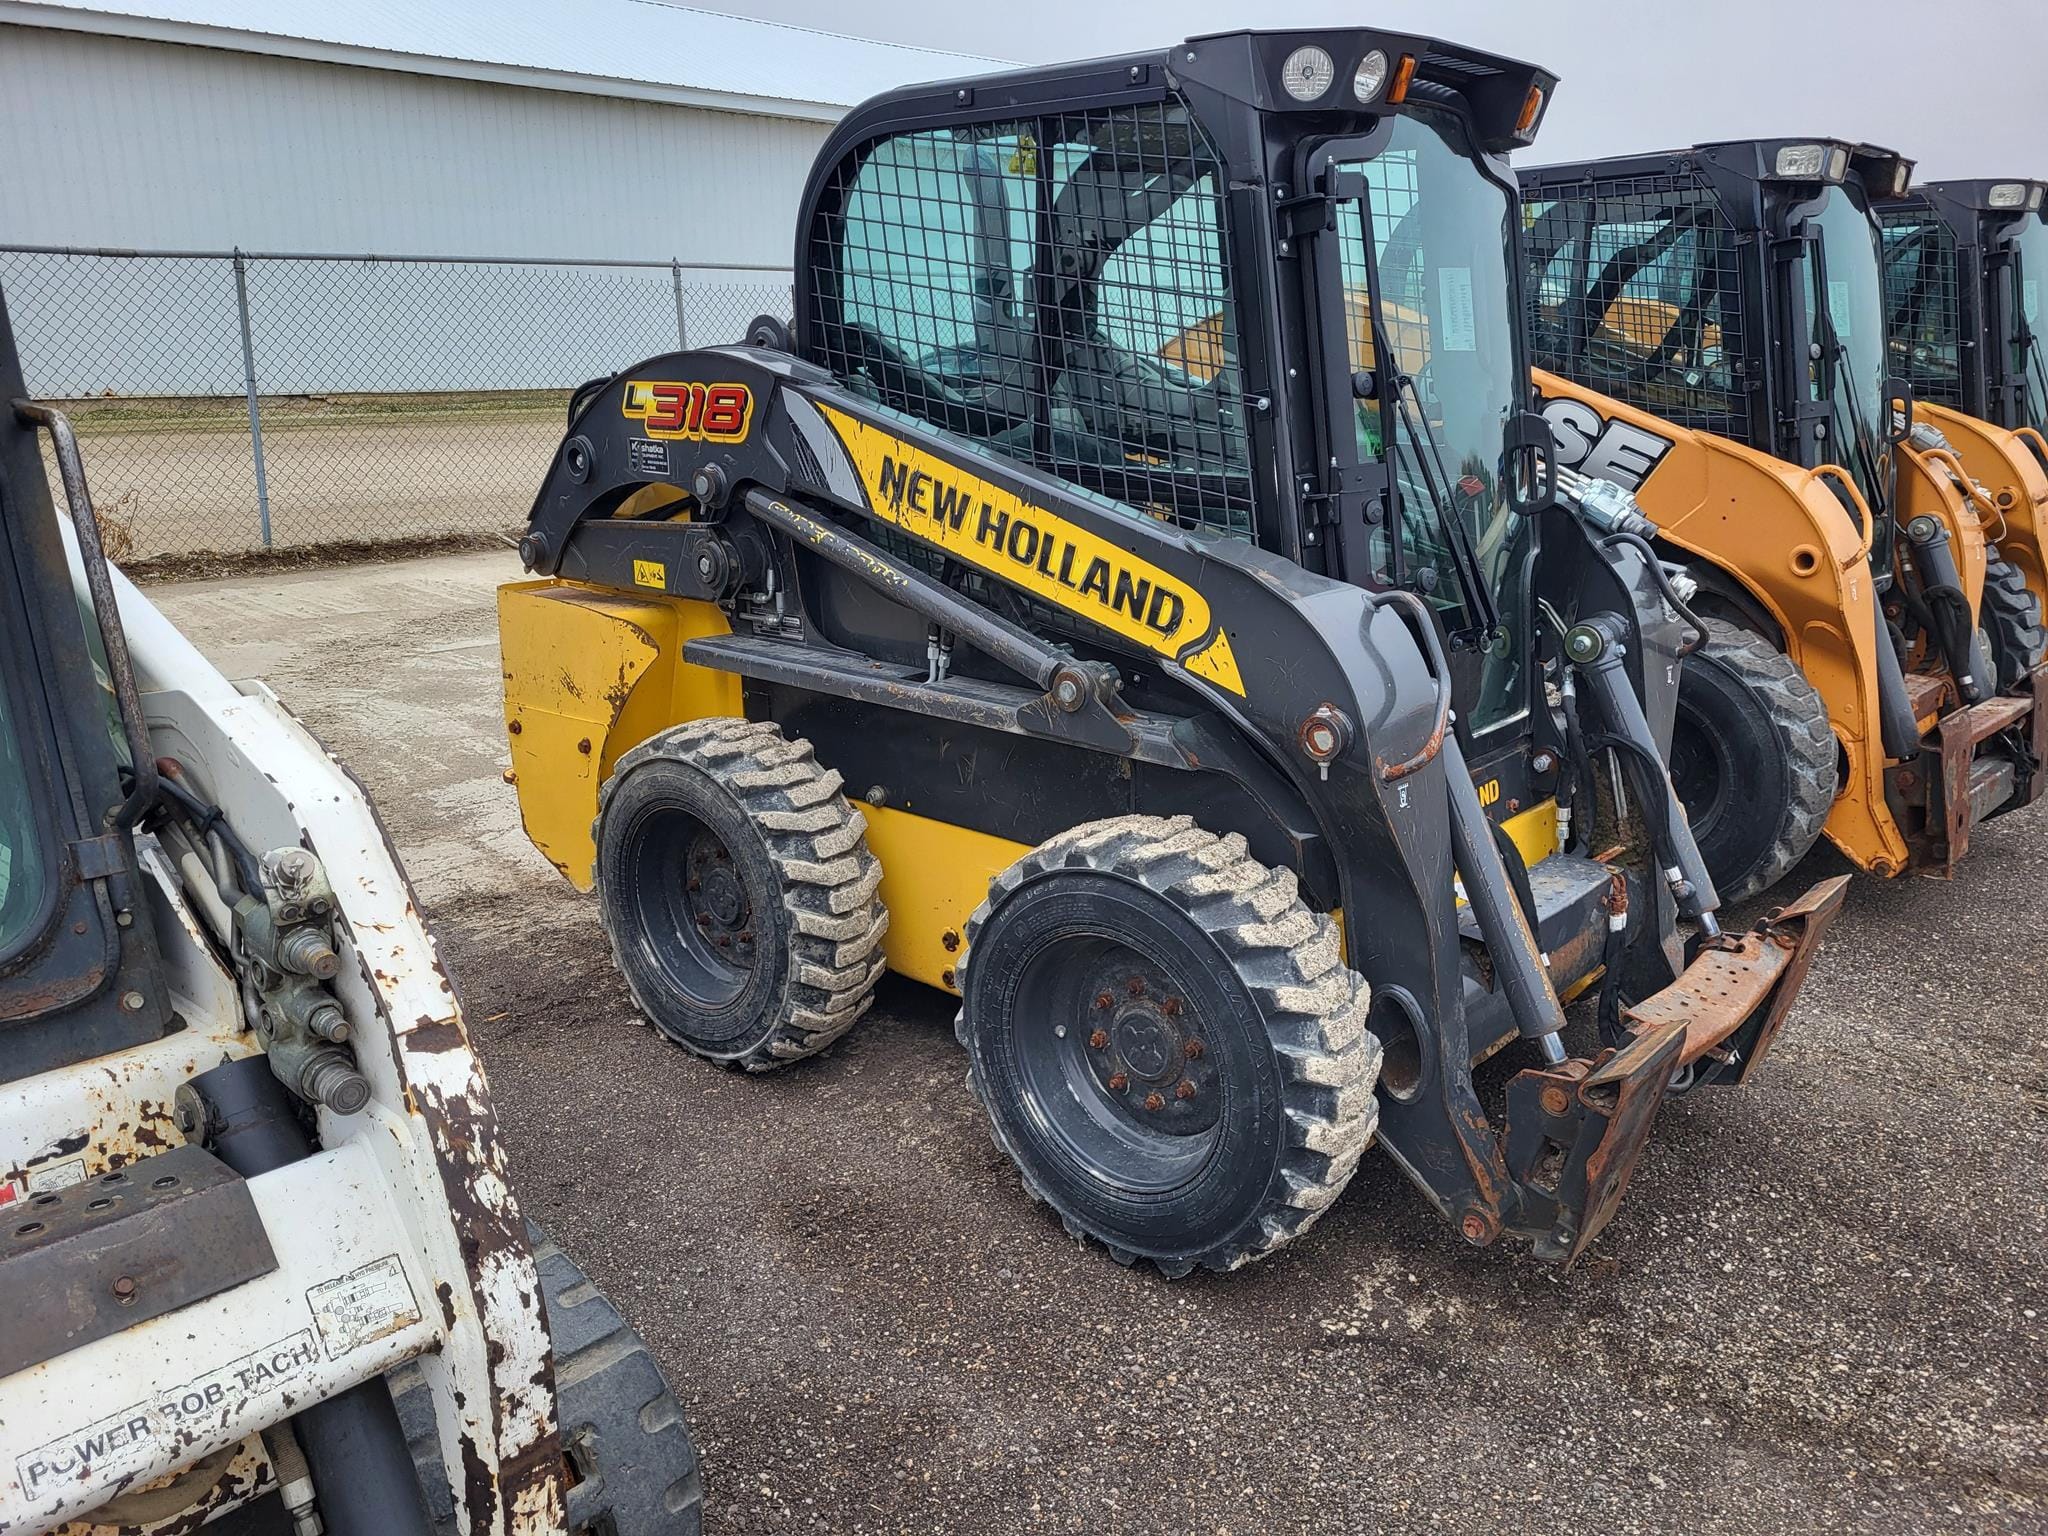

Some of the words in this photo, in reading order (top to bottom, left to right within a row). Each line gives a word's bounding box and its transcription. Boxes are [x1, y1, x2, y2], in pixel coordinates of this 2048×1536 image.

[878, 454, 972, 533] NEW
[974, 502, 1186, 637] HOLLAND
[1476, 779, 1500, 808] ND
[27, 1415, 151, 1488] POWER
[158, 1341, 315, 1421] BOB-TACH
